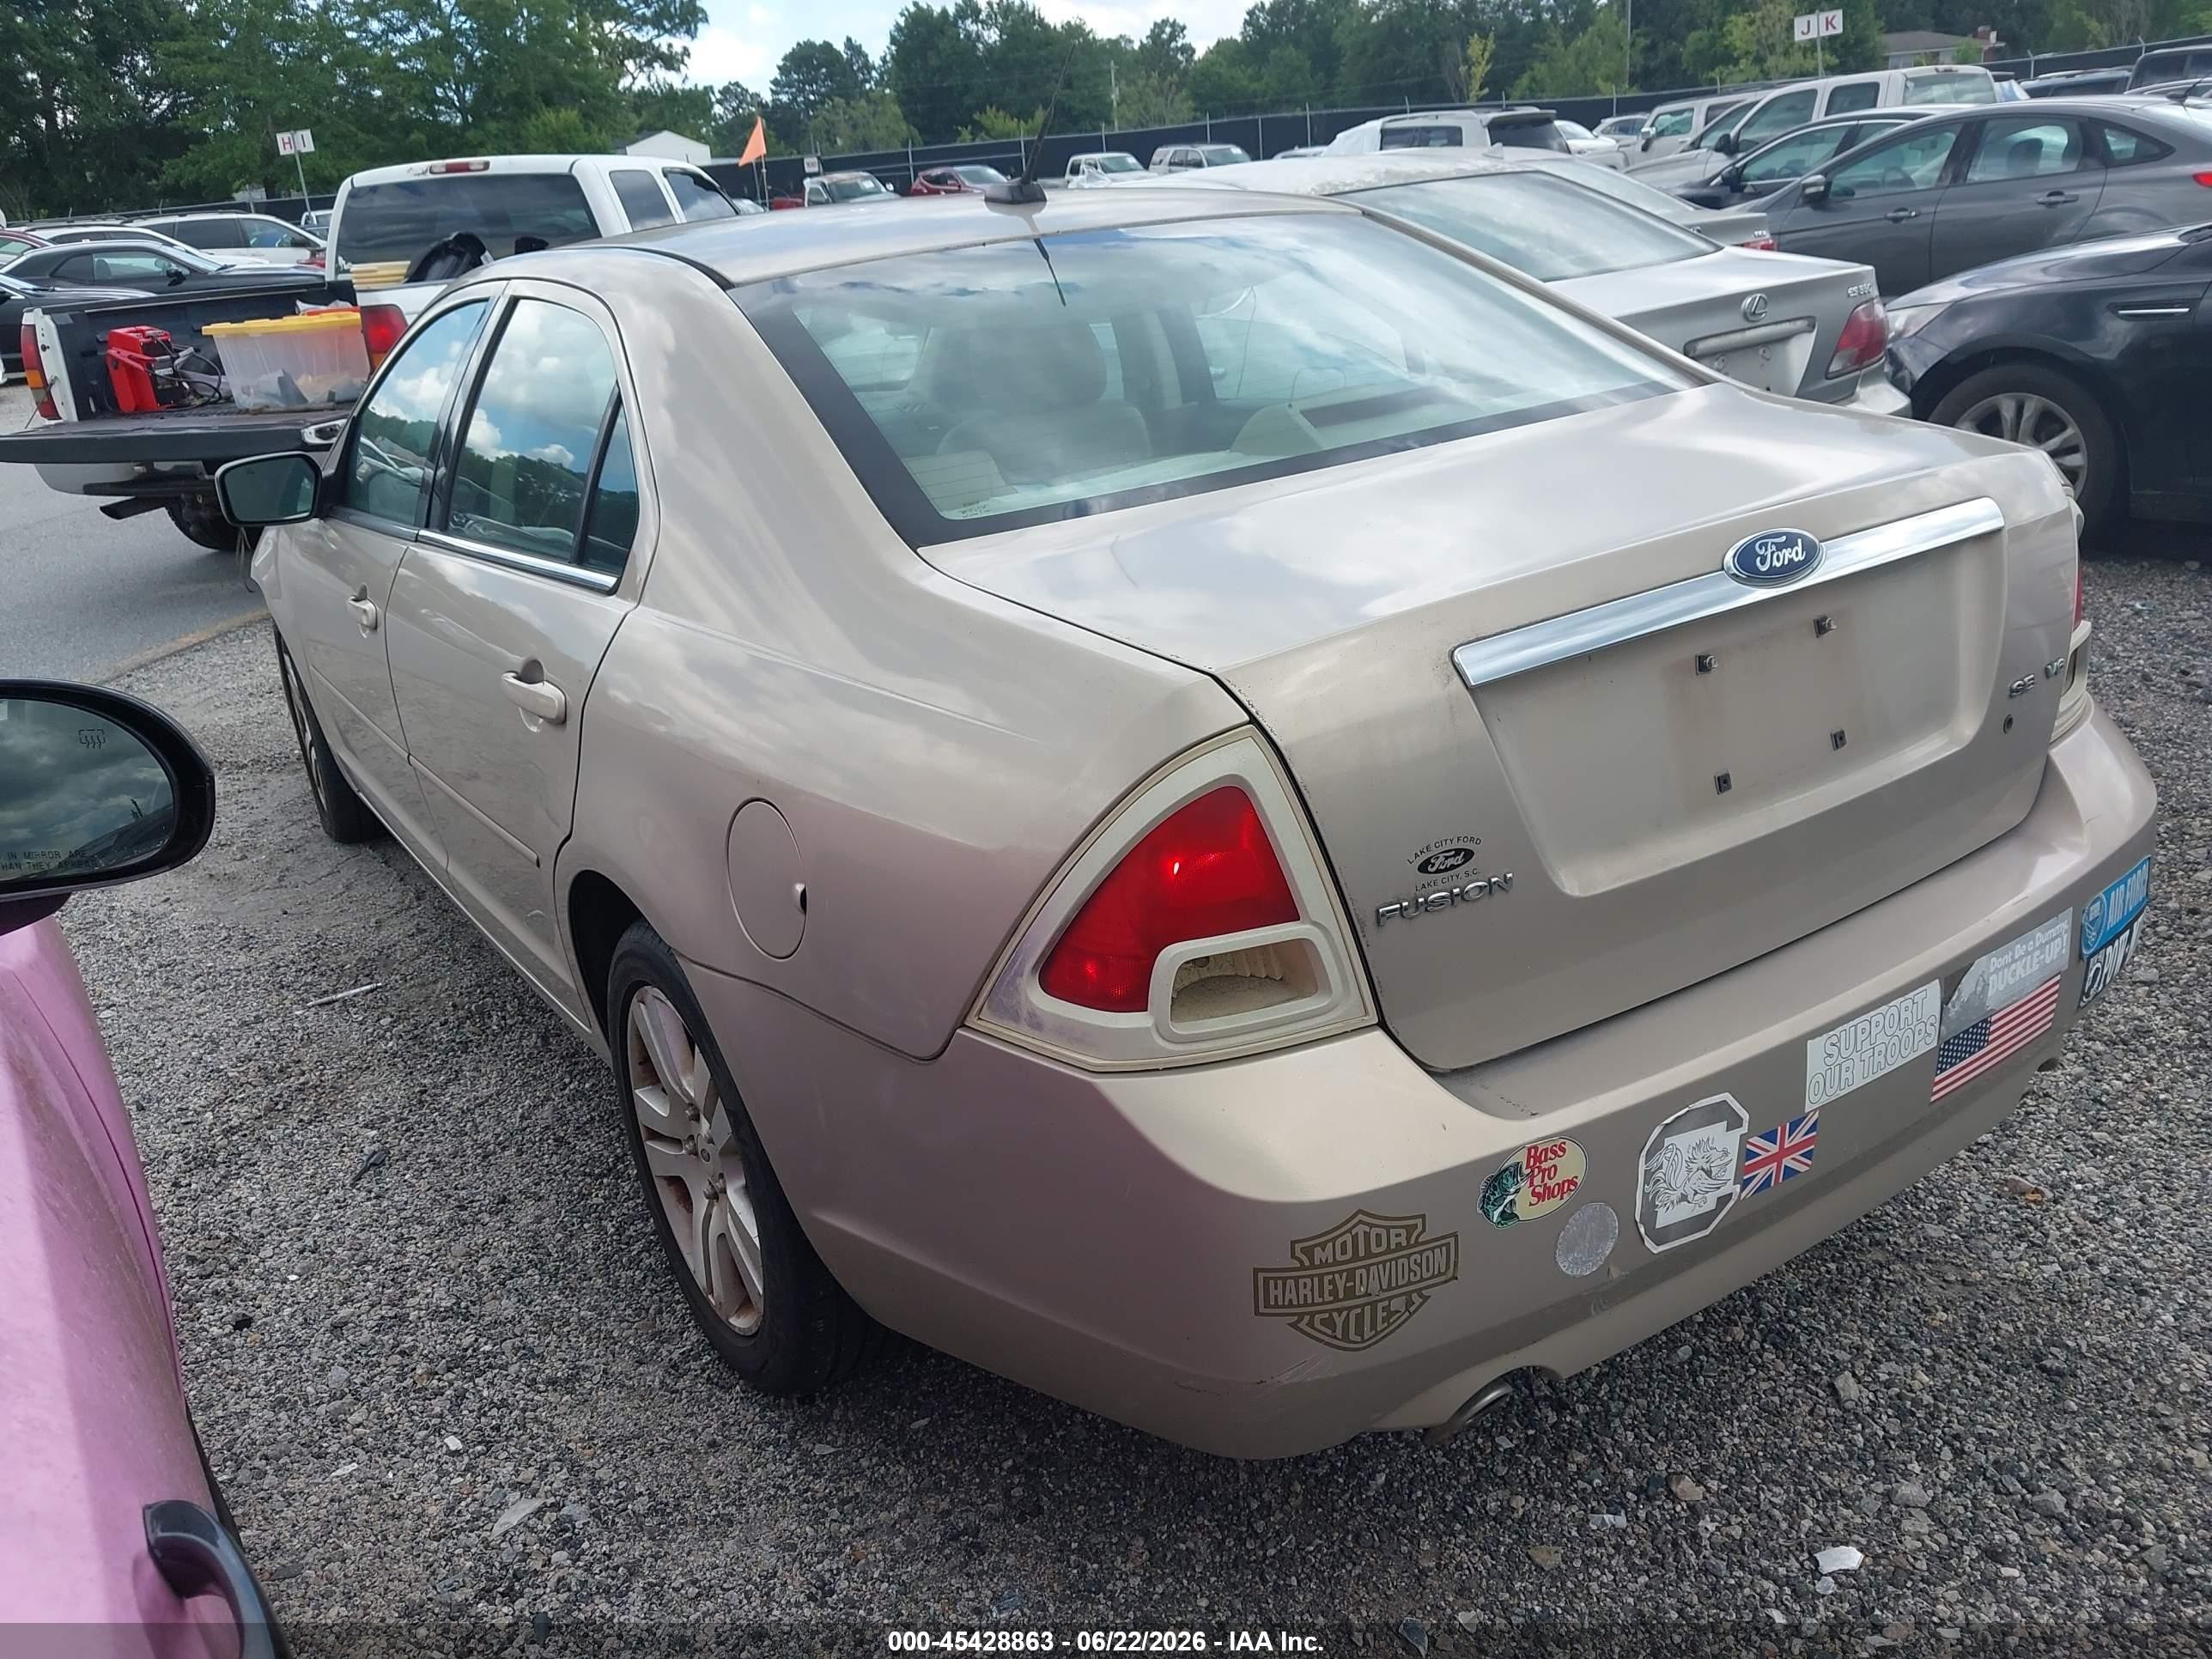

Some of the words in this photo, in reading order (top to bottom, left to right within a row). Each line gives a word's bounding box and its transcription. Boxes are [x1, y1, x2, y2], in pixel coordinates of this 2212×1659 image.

[1801, 20, 1811, 35] J
[1826, 15, 1837, 32] K
[281, 136, 293, 151] H
[1755, 535, 1806, 572] Ford
[2008, 673, 2034, 698] SE
[23, 851, 62, 860] MIRROR
[69, 849, 87, 858] ARE
[1407, 844, 1431, 866] LAKE
[1434, 837, 1455, 849] CITY
[1456, 836, 1481, 846] FORD
[1427, 851, 1465, 872] Ford
[1, 862, 21, 871] HAN
[26, 861, 51, 870] THEY
[1415, 879, 1438, 892] LAKE
[1464, 868, 1480, 878] S.C.
[1376, 872, 1513, 927] FUSION
[2107, 884, 2125, 931] AIR
[2027, 940, 2034, 951] a
[1824, 989, 1928, 1066] SUPPORT
[1808, 1058, 1855, 1105] OUR
[1860, 1014, 1936, 1079] TROOPS
[1525, 1141, 1567, 1170] Bass
[1528, 1164, 1559, 1189] Pro
[1528, 1176, 1578, 1207] Shops
[1314, 1223, 1407, 1265] MOTOR
[1268, 1246, 1447, 1306] HARLEY-DAVIDSON
